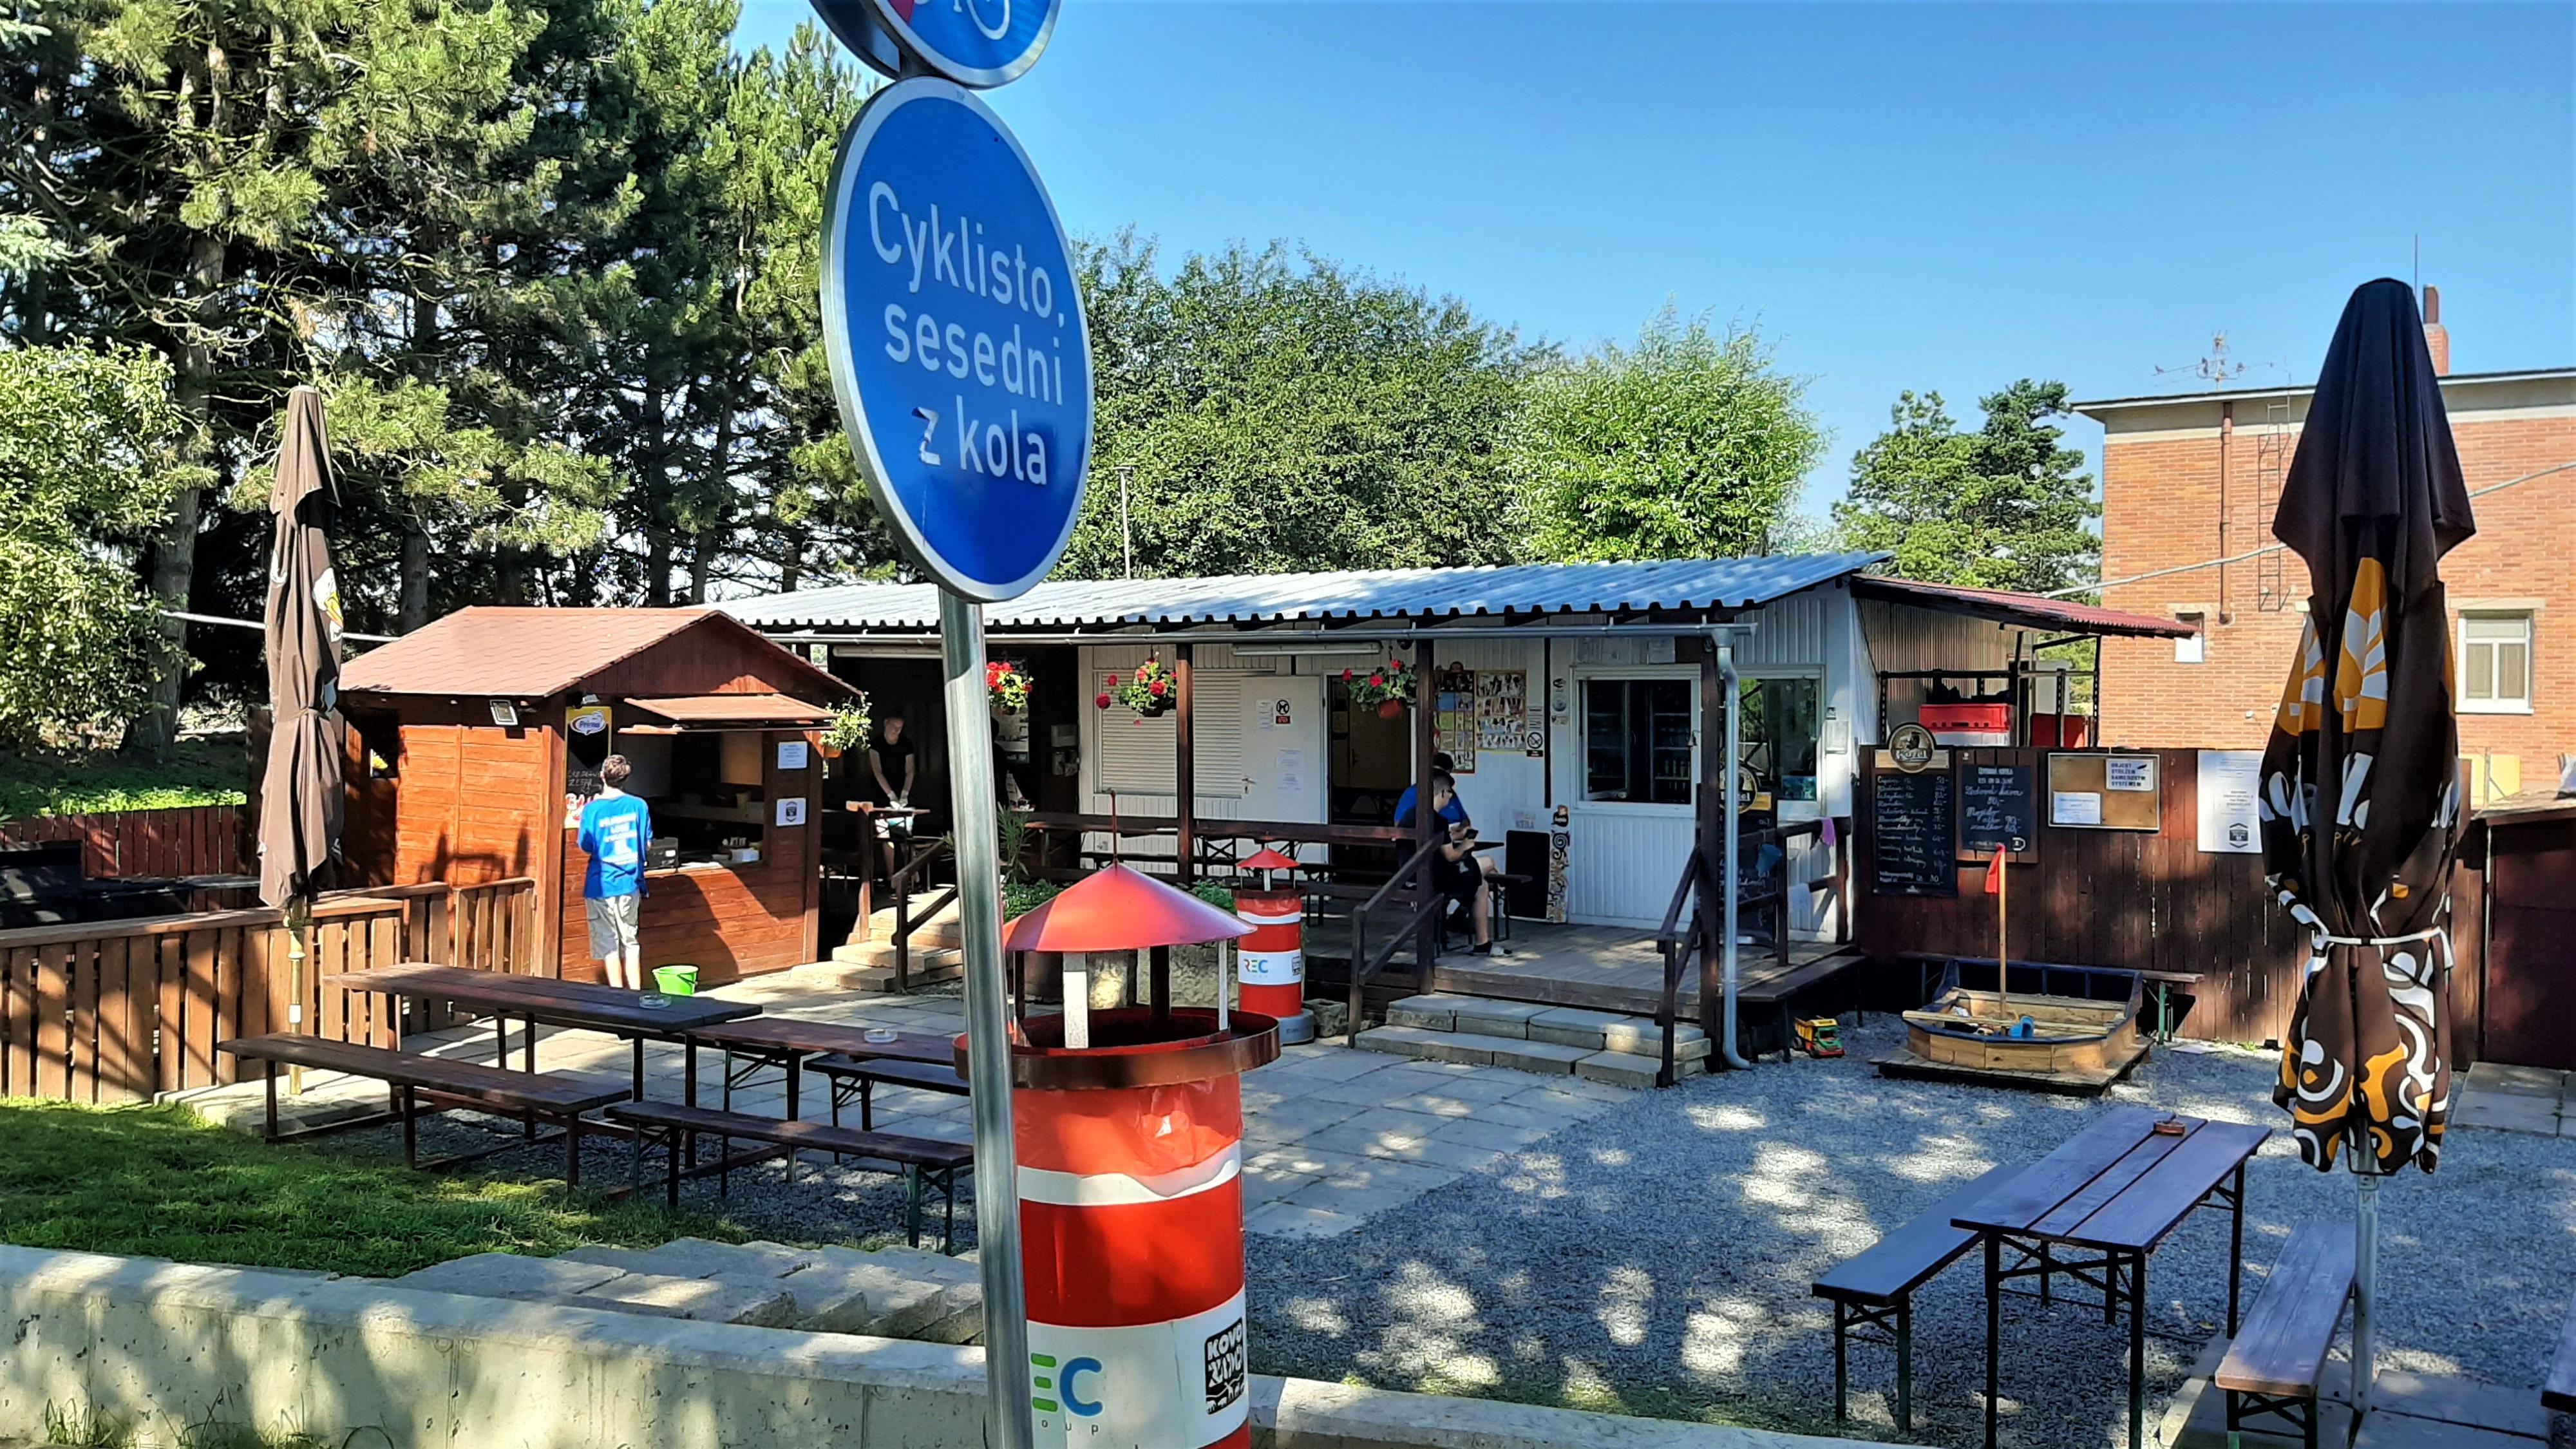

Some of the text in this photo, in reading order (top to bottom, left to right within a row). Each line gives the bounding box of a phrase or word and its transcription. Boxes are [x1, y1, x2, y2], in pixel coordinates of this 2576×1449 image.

[869, 180, 1065, 328] Cyklisto,
[884, 301, 1064, 406] sesedni
[913, 394, 1048, 486] z kola
[1243, 958, 1269, 974] REC
[1207, 1322, 1243, 1361] KOVO
[1030, 1352, 1103, 1417] EC
